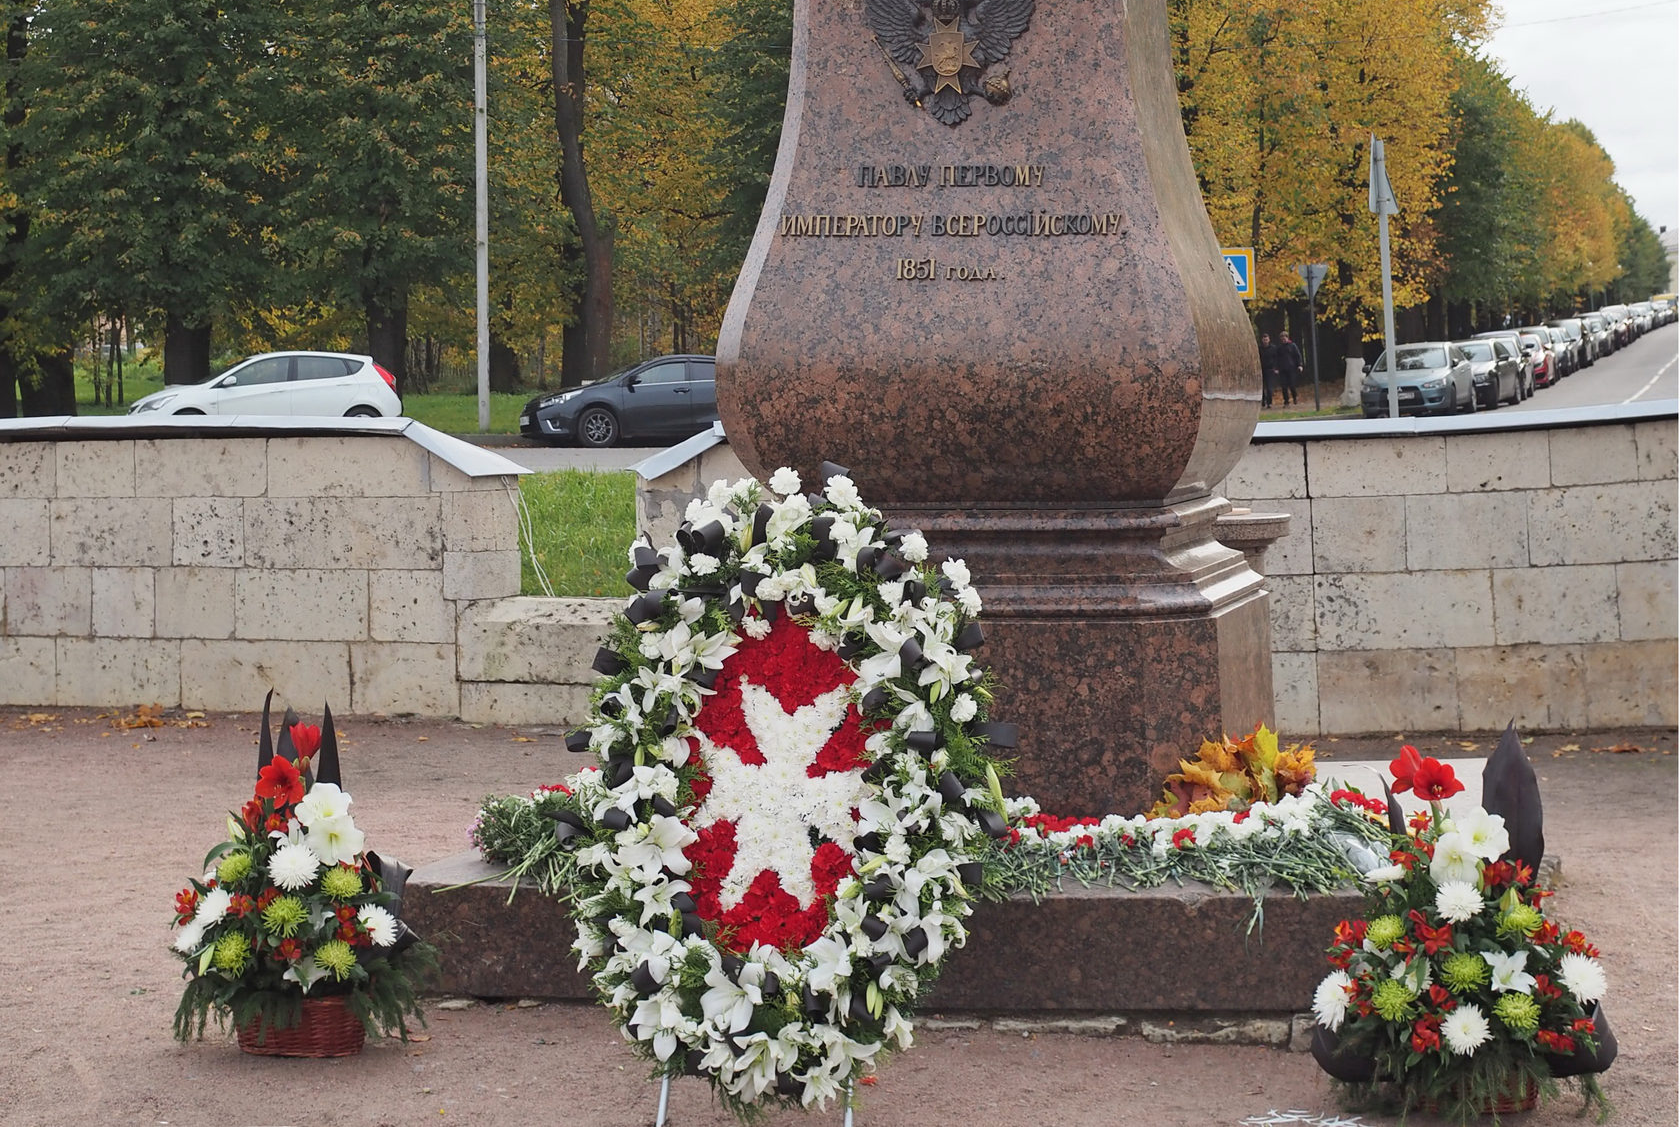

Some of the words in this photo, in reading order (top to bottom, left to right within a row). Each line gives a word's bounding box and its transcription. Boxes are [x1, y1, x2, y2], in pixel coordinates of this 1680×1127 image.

[857, 165, 931, 188] ПАВЛУ
[939, 164, 1045, 187] ПЕРВОМУ
[781, 214, 923, 237] ИМПЕРАТОРУ
[896, 258, 936, 280] 1851
